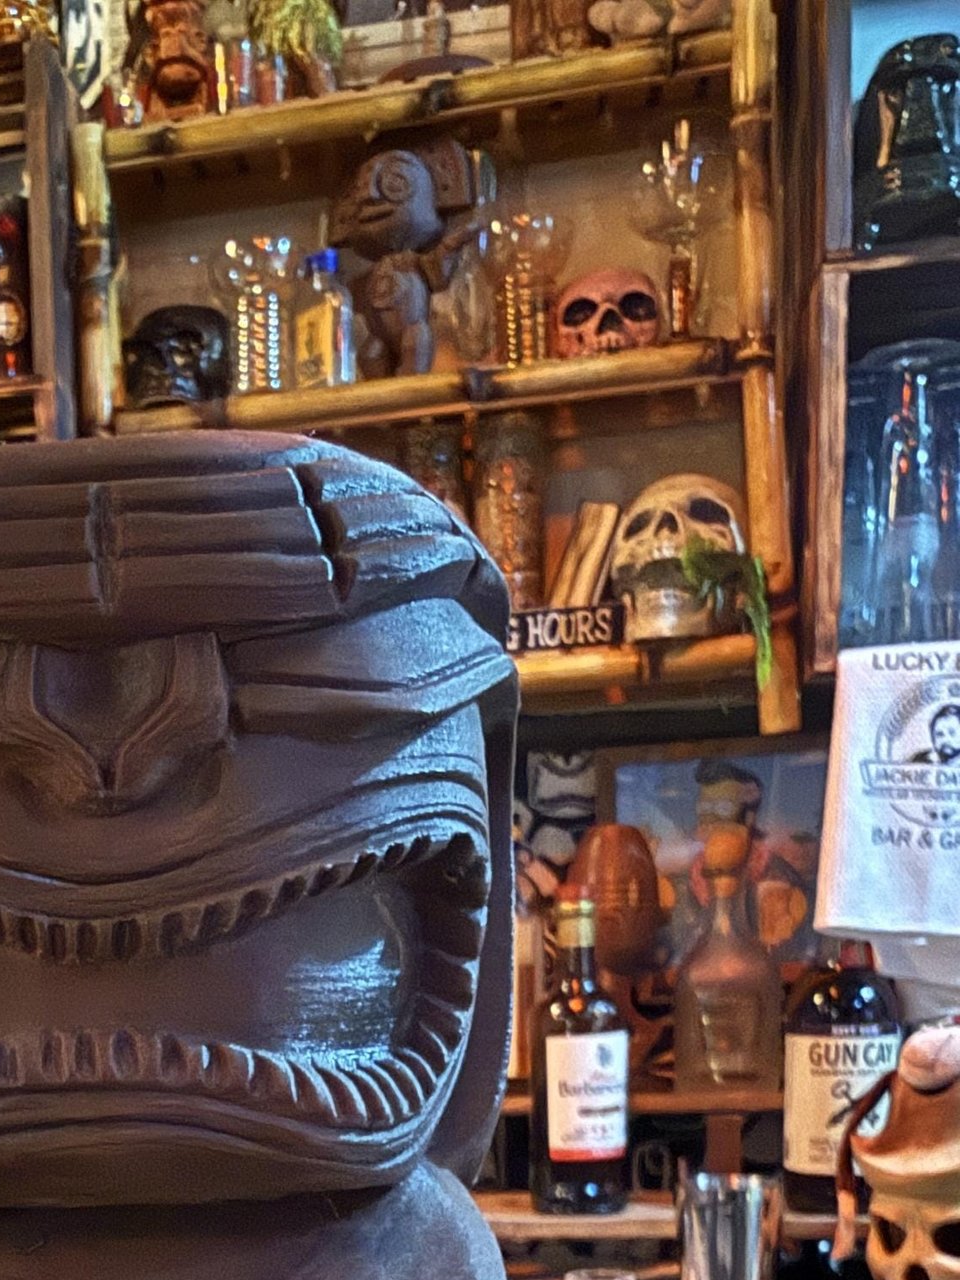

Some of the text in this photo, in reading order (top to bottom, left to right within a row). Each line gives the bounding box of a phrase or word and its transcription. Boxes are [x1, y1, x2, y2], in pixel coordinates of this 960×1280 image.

[527, 608, 613, 648] HOURS
[872, 652, 950, 671] LUCKY
[871, 825, 911, 848] BAR
[808, 1041, 893, 1067] GUN CAY
